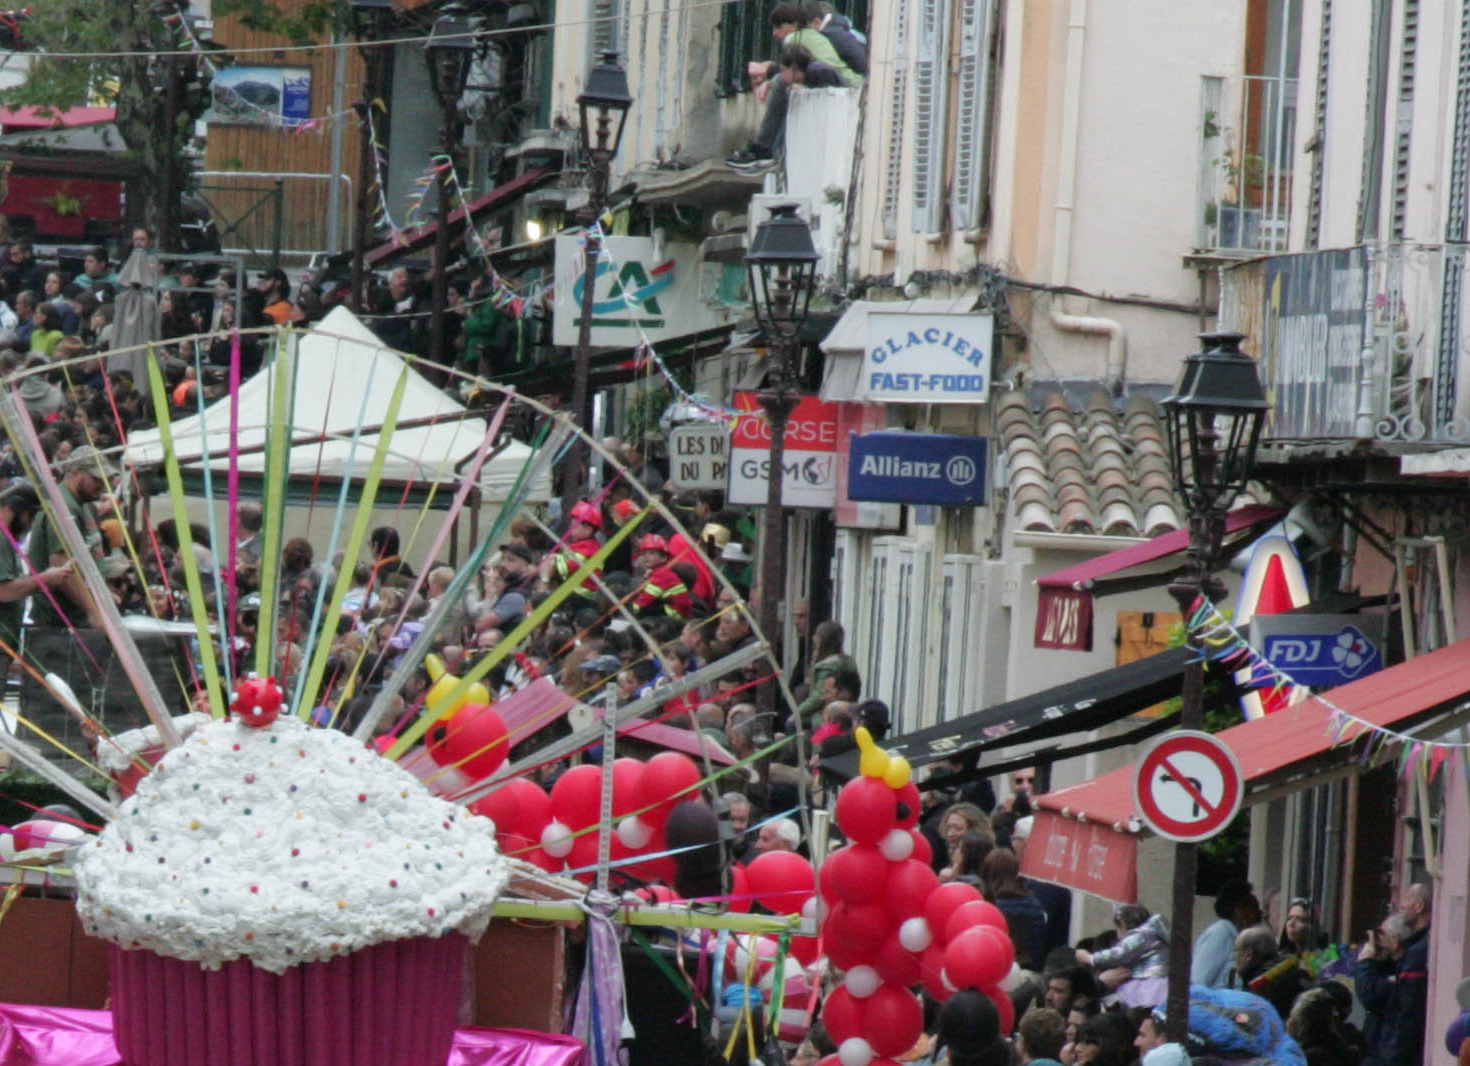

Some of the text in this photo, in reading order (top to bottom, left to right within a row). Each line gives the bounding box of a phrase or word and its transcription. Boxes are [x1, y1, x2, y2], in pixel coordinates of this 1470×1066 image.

[871, 328, 984, 368] GLACIER
[870, 373, 983, 392] FAST-FOOD
[677, 436, 705, 456] LES
[681, 462, 699, 481] DU
[860, 455, 942, 479] Allianz
[1270, 640, 1322, 662] FDJ
